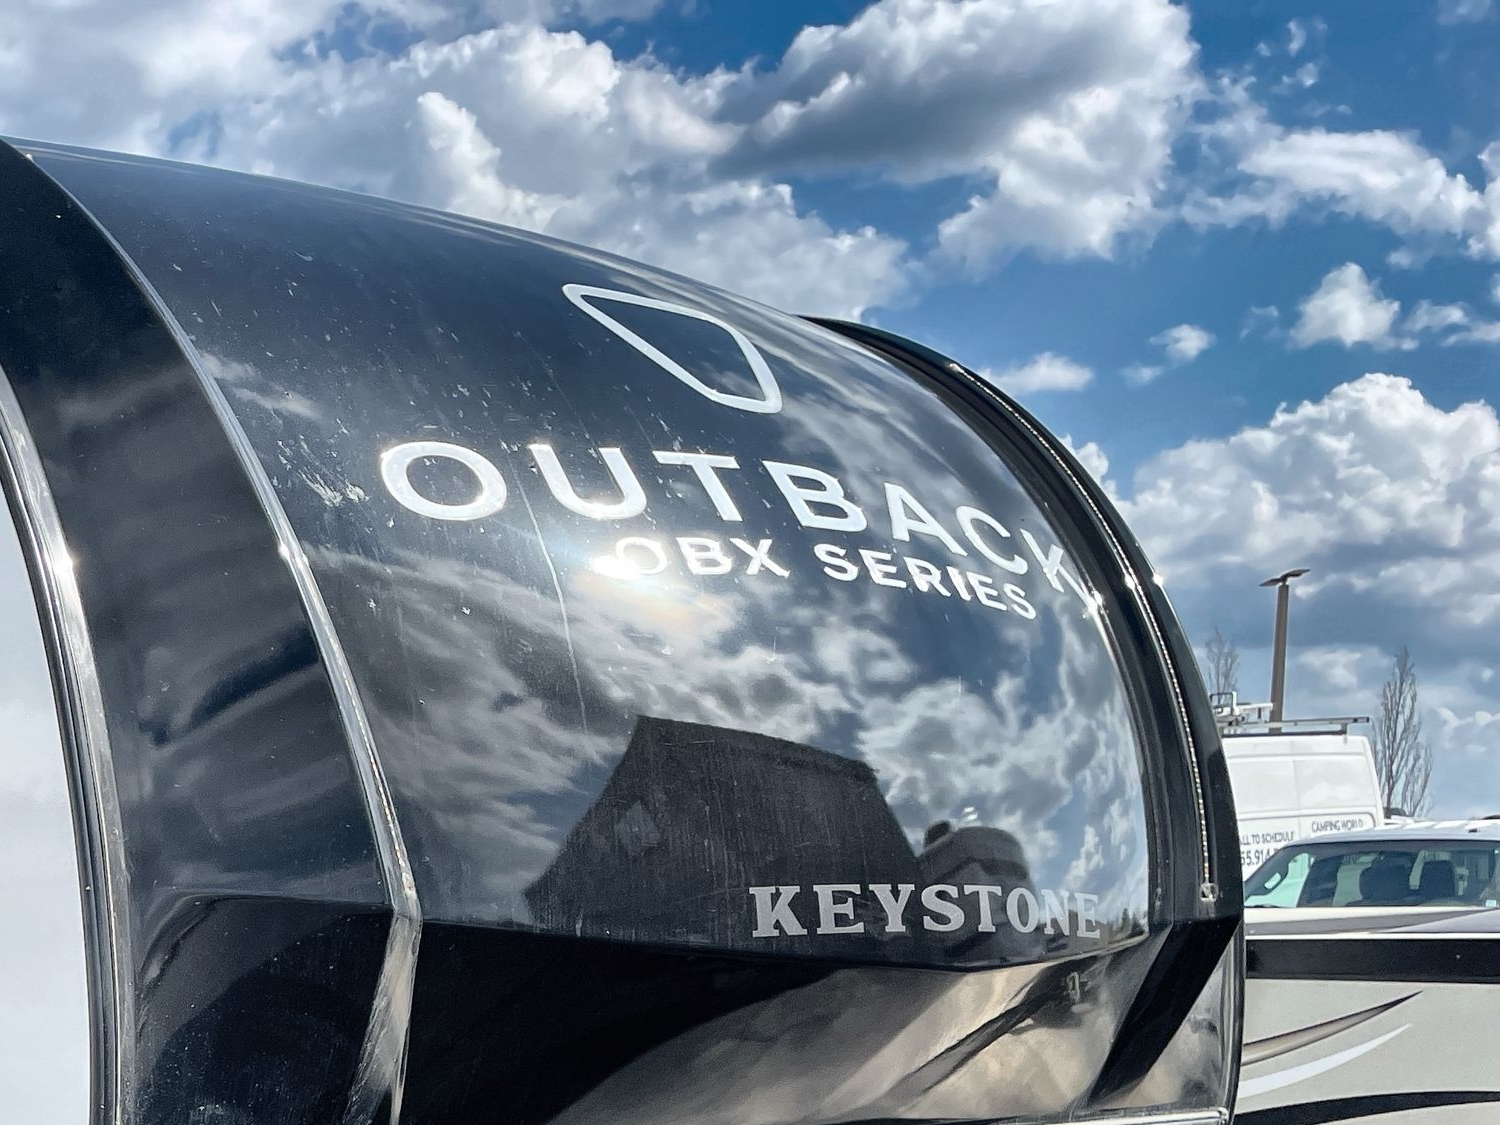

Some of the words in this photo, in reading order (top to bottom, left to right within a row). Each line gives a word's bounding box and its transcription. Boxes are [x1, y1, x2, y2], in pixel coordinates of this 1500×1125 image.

[380, 441, 1094, 606] OUTBACK
[613, 536, 790, 578] OBX
[813, 542, 1037, 620] SERIES
[1252, 833, 1261, 845] TO
[748, 883, 1101, 938] KEYSTONE
